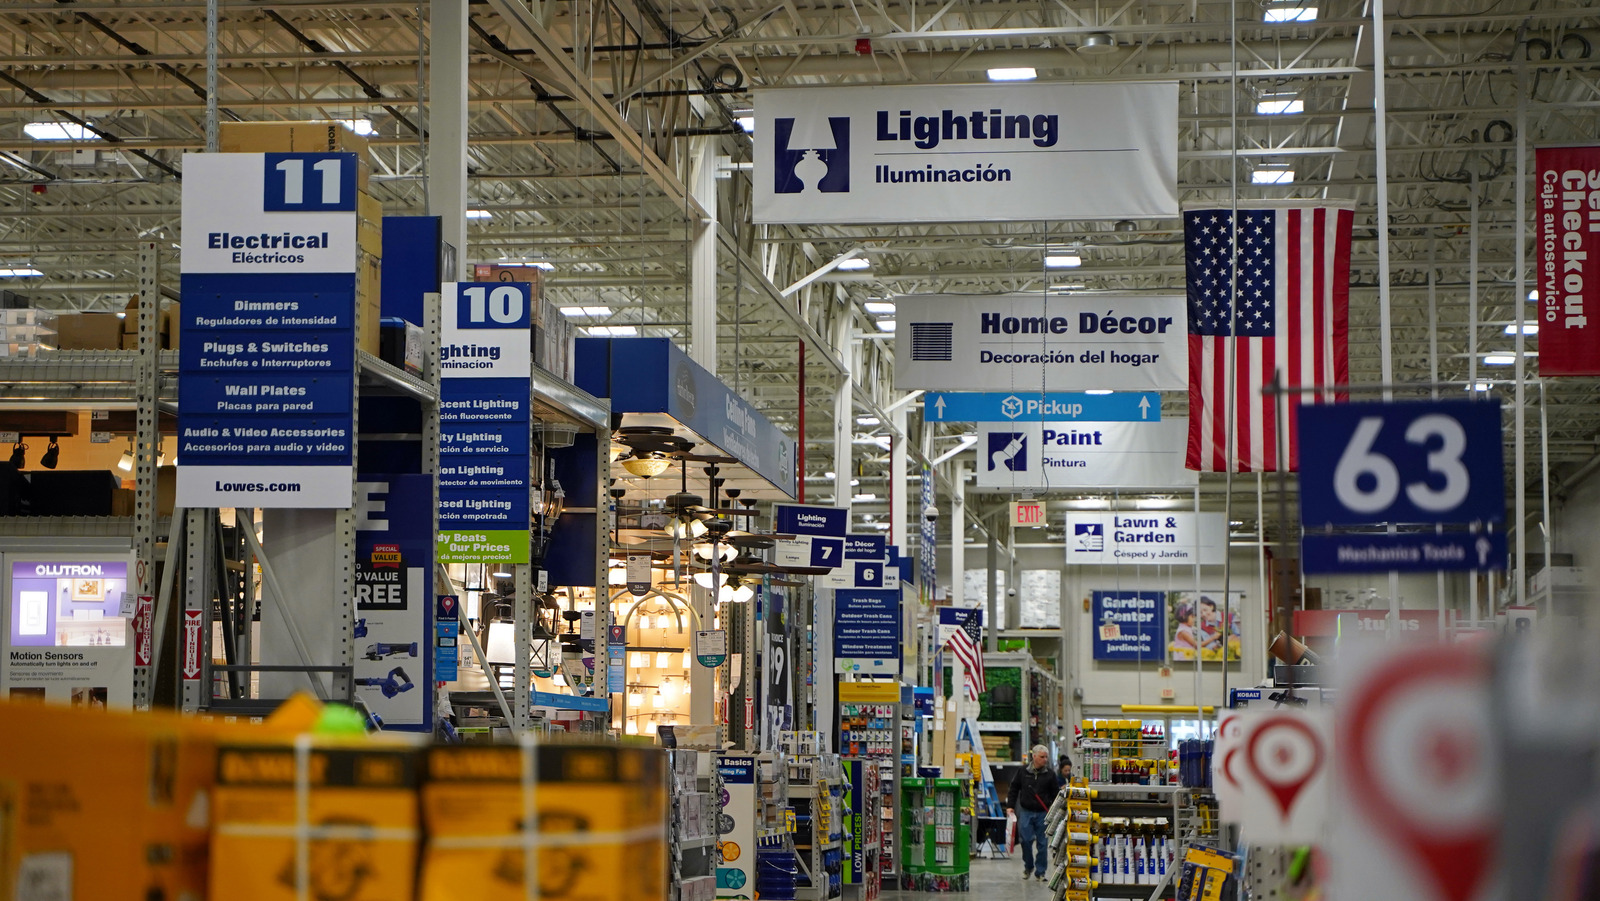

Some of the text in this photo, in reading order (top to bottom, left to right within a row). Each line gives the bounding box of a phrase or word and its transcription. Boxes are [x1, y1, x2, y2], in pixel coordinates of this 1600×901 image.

[876, 108, 1059, 149] Lighting
[875, 163, 1012, 184] Iluminación
[275, 158, 341, 204] 11
[208, 232, 328, 249] Electrical
[1541, 169, 1560, 322] Caja autoservicio
[1561, 169, 1588, 329] Checkout
[231, 251, 305, 264] Eléctricos
[234, 300, 299, 311] Dimmers
[463, 286, 524, 323] 10
[196, 315, 337, 327] Reguladores de intensidad
[981, 310, 1172, 334] Home Décor
[203, 342, 329, 355] Plugs & Switches
[200, 358, 249, 367] Enchufes
[261, 358, 332, 369] Interruptores
[980, 350, 1159, 367] Decoración del hogar
[225, 385, 306, 396] Wall Plates
[217, 401, 314, 412] Placas para pared
[473, 399, 519, 410] Lighting
[1026, 400, 1083, 418] Pickup
[184, 427, 345, 437] Audio & Video Accessories
[456, 433, 502, 443] Lighting
[1042, 429, 1103, 446] Paint
[184, 443, 345, 454] Accesorios para audio y video
[1042, 457, 1087, 467] Pintura
[1333, 413, 1470, 513] 63
[458, 466, 504, 476] Lighting
[215, 480, 301, 492] Lowes.com
[356, 482, 389, 531] E
[466, 499, 512, 510] Lighting
[797, 513, 827, 523] Lighting
[1017, 505, 1039, 523] EXIT
[1114, 516, 1177, 528] Lawn &
[453, 533, 487, 542] Beats
[1114, 530, 1176, 544] Garden
[449, 543, 510, 552] Our Prices
[821, 546, 833, 560] 7
[1423, 545, 1465, 561] Tools
[364, 572, 398, 581] VALUE
[863, 568, 875, 581] 6
[357, 584, 401, 603] REE
[1103, 597, 1155, 608] Garden
[1104, 610, 1154, 622] Center
[1139, 633, 1151, 641] de
[10, 651, 84, 660] Motion Sensors
[854, 813, 862, 873] LOW PRICES!
